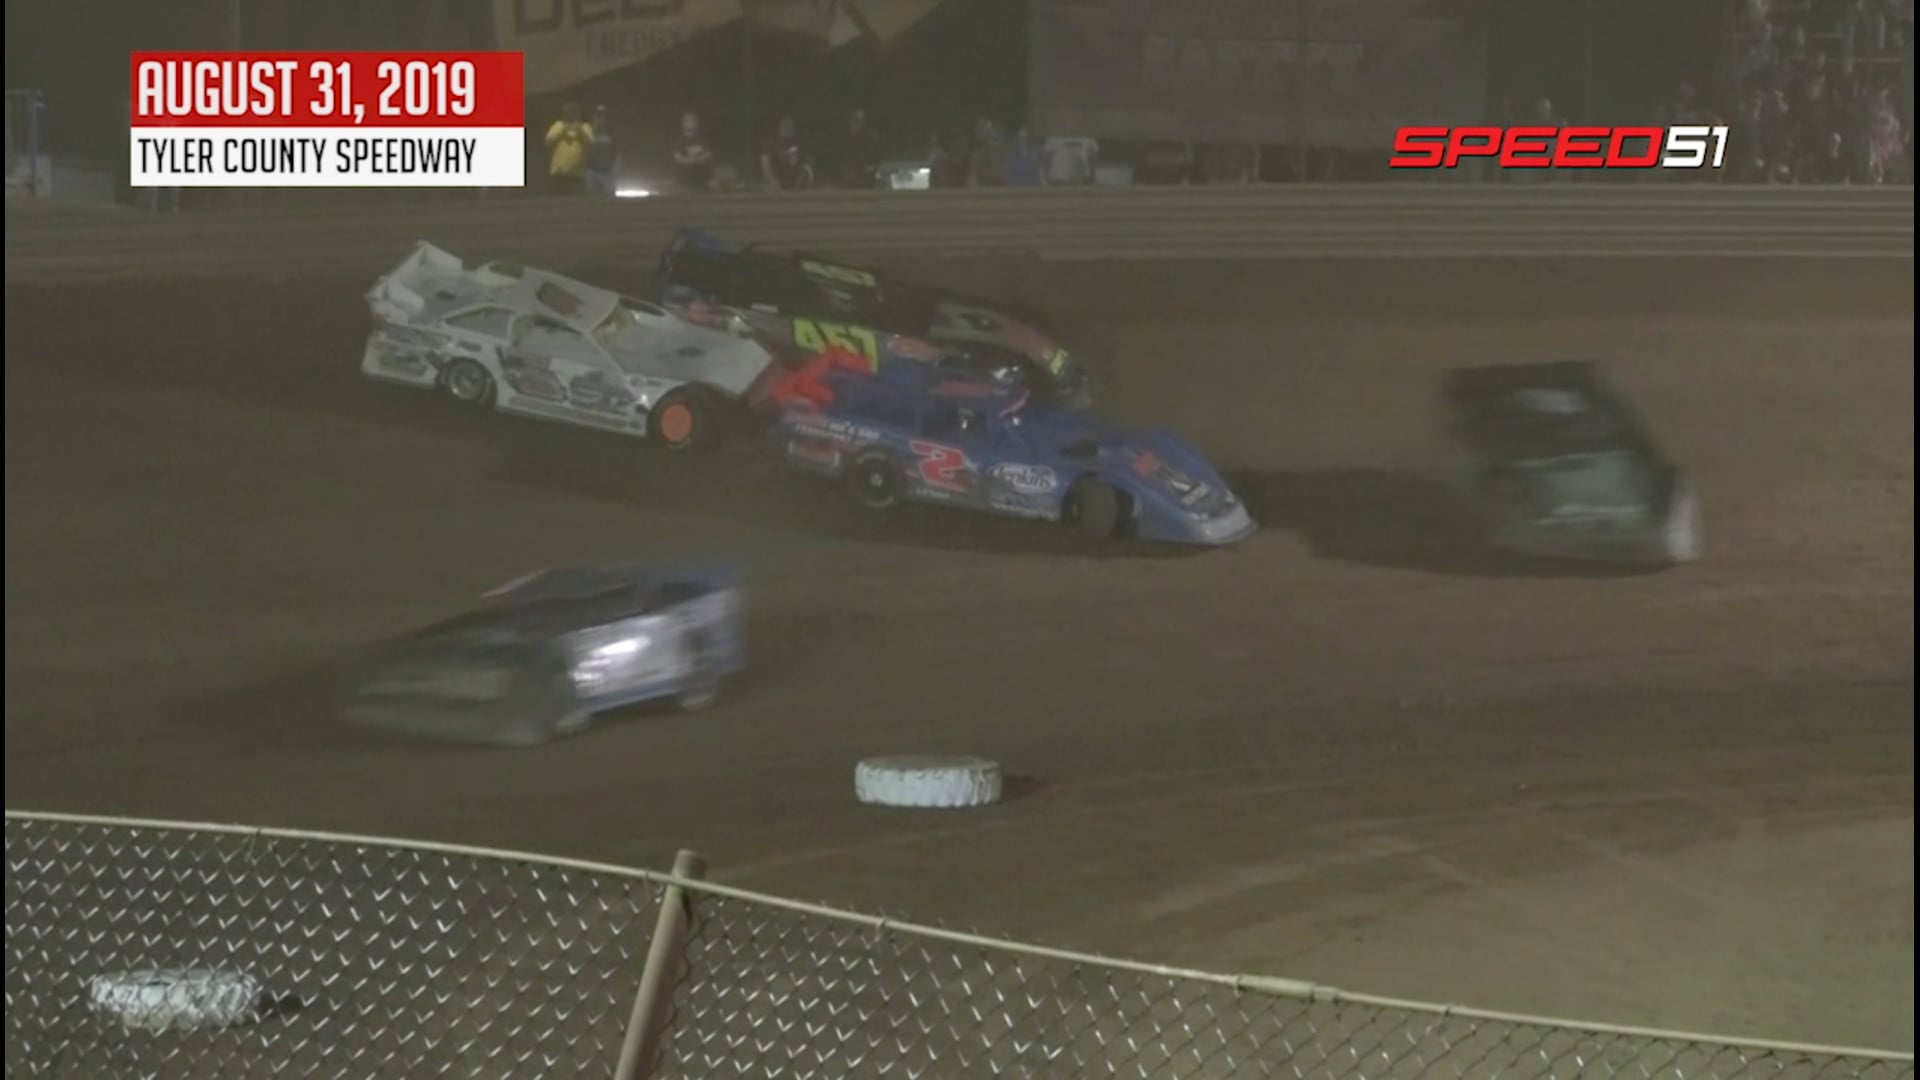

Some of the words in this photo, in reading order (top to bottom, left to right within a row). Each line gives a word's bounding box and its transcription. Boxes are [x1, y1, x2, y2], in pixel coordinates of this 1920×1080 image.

[793, 316, 879, 374] 457
[908, 438, 970, 492] 2
[993, 463, 1053, 491] Jenkins
